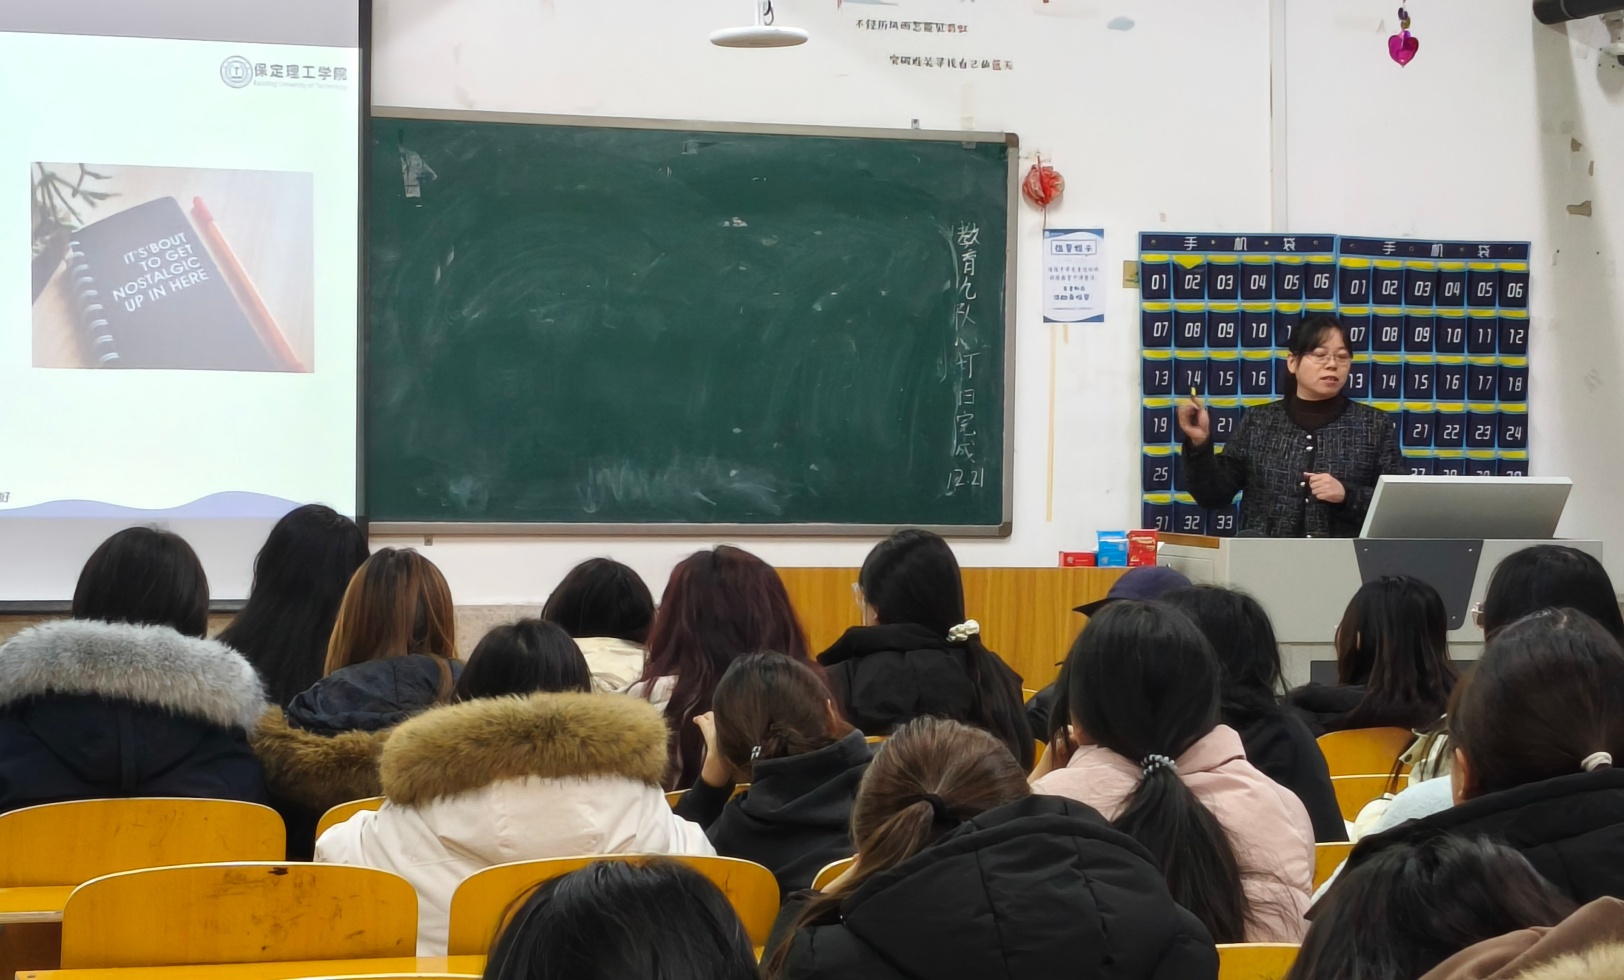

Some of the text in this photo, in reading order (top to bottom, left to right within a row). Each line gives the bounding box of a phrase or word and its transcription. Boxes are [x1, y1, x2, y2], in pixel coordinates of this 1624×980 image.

[254, 62, 347, 81] 保定理工学院
[139, 244, 193, 271] TO GET
[112, 257, 200, 301] NOSTALGIC
[1152, 274, 1329, 289] 01 02 03 04 05 06
[125, 269, 209, 311] UP IN HERE
[1351, 280, 1523, 297] 01 02 03 04 05 06
[1154, 322, 1168, 336] 07
[1185, 323, 1201, 337] 08
[1218, 323, 1234, 337] 09
[1252, 323, 1267, 338] 10
[1351, 327, 1523, 343] 07 08 09 10 11 12
[1156, 371, 1266, 385] 13 14 15 16
[1349, 373, 1522, 391] 13 14 15 16 17 18
[1154, 418, 1232, 432] 19 21
[1413, 424, 1521, 440] 21 22 23 24
[1154, 467, 1168, 480] 25
[1155, 516, 1232, 530] 31 32 33
